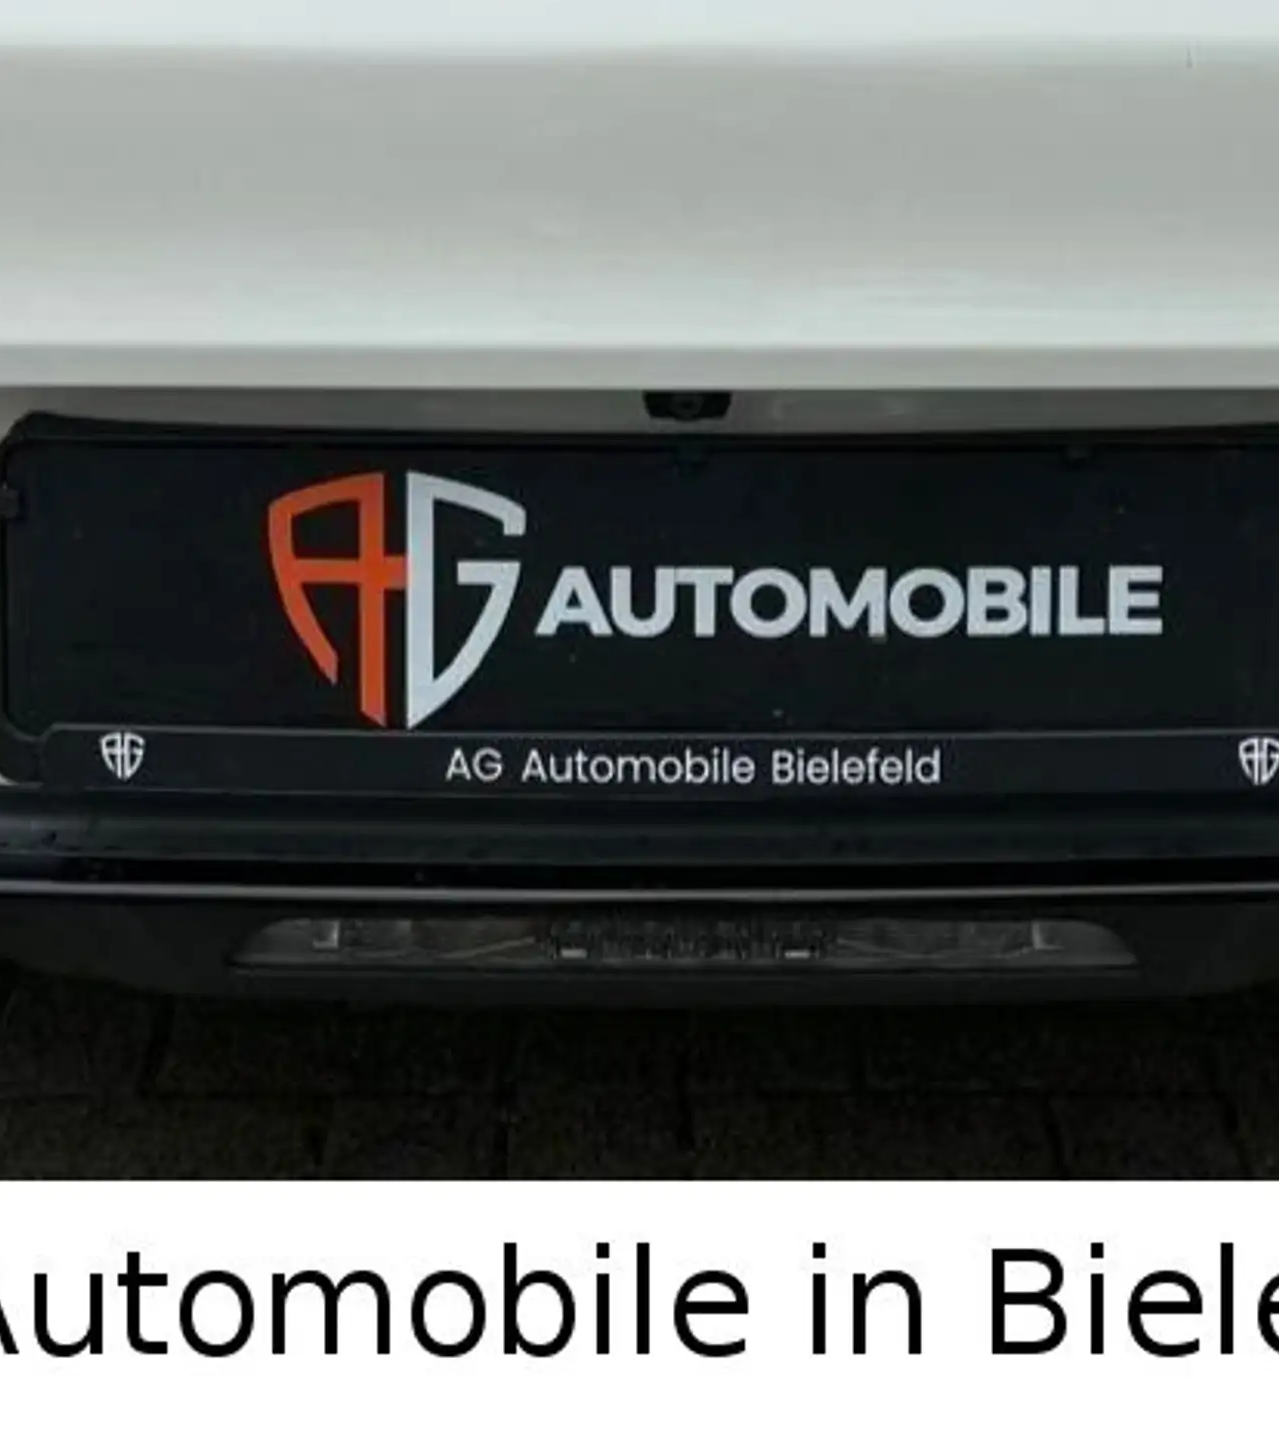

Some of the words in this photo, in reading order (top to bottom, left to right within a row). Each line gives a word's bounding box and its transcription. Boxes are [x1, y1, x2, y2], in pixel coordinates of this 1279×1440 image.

[269, 471, 526, 727] AG
[535, 565, 1163, 638] AUTOMOBILE
[446, 747, 503, 782] AG
[521, 747, 755, 784] Automobile
[772, 748, 941, 784] Bielefeld
